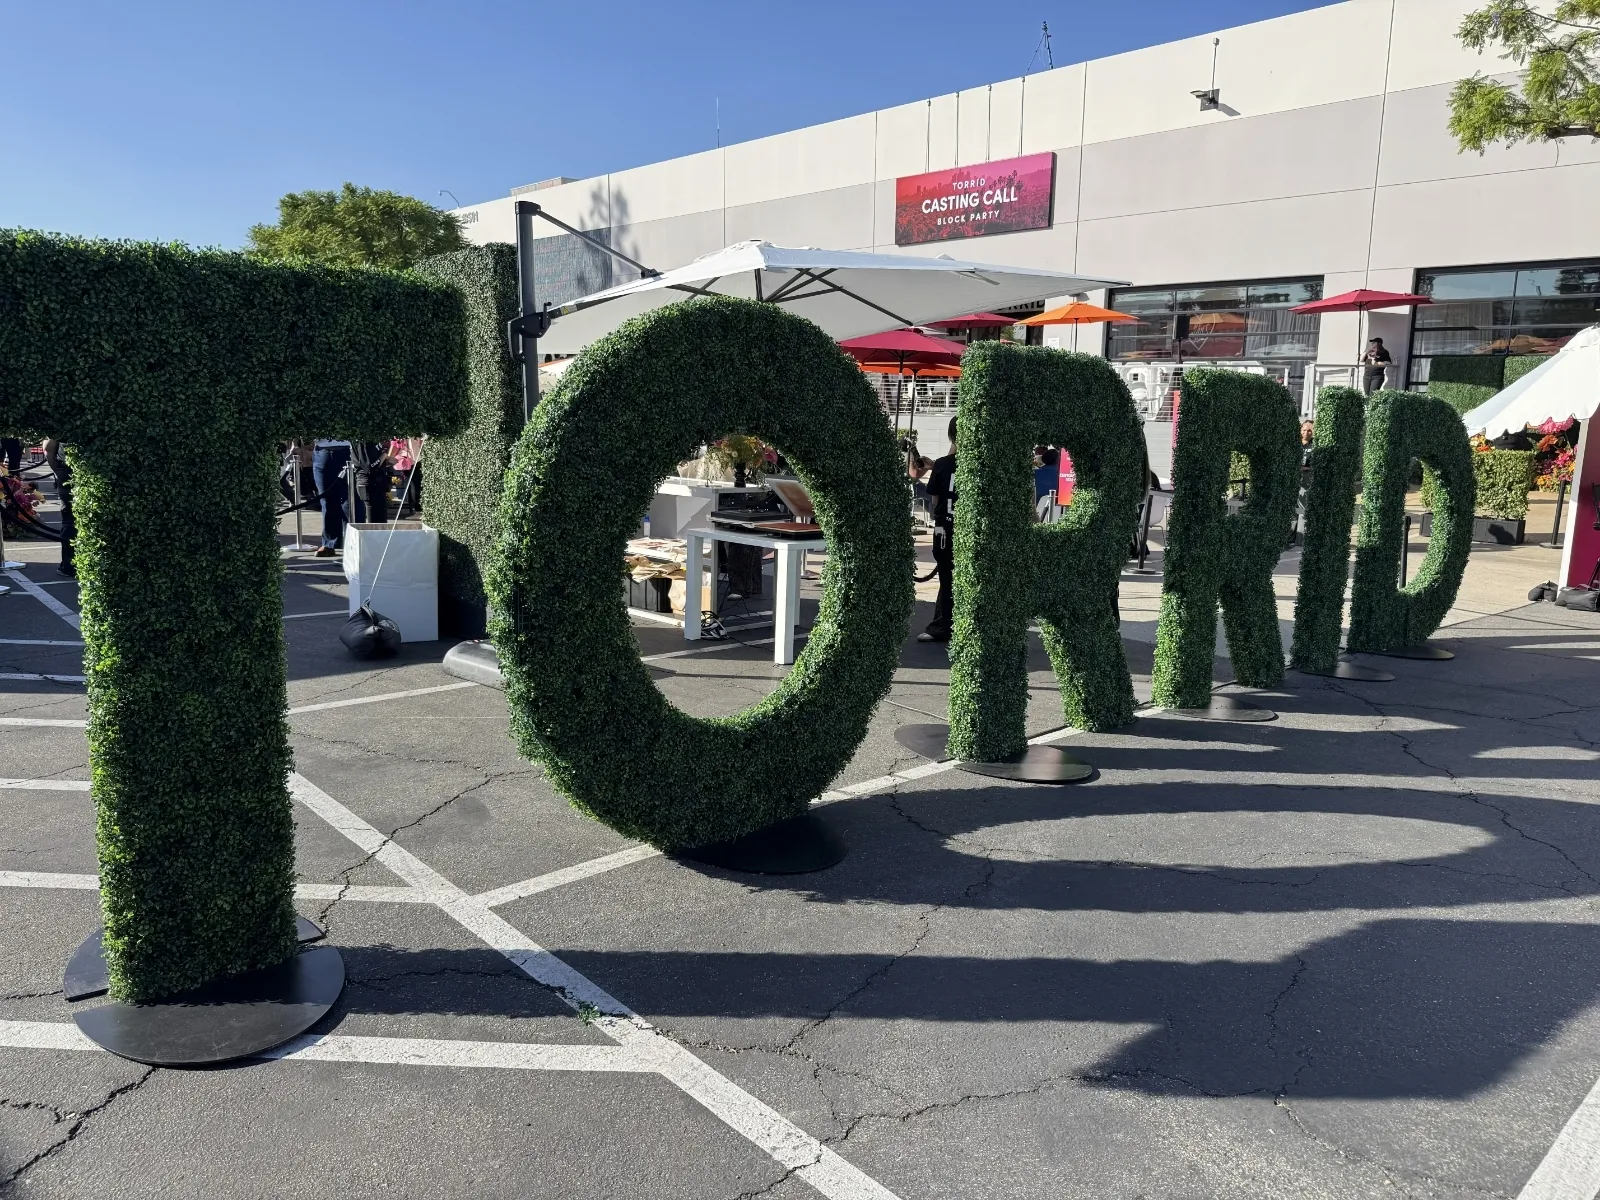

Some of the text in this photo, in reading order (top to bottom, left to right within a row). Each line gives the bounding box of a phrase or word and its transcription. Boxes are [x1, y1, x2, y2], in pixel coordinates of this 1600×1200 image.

[953, 178, 985, 190] TORRID
[922, 187, 1018, 214] CASTING CALL
[937, 209, 1000, 226] BLOCK PARTY
[0, 228, 1475, 1004] TORRID
